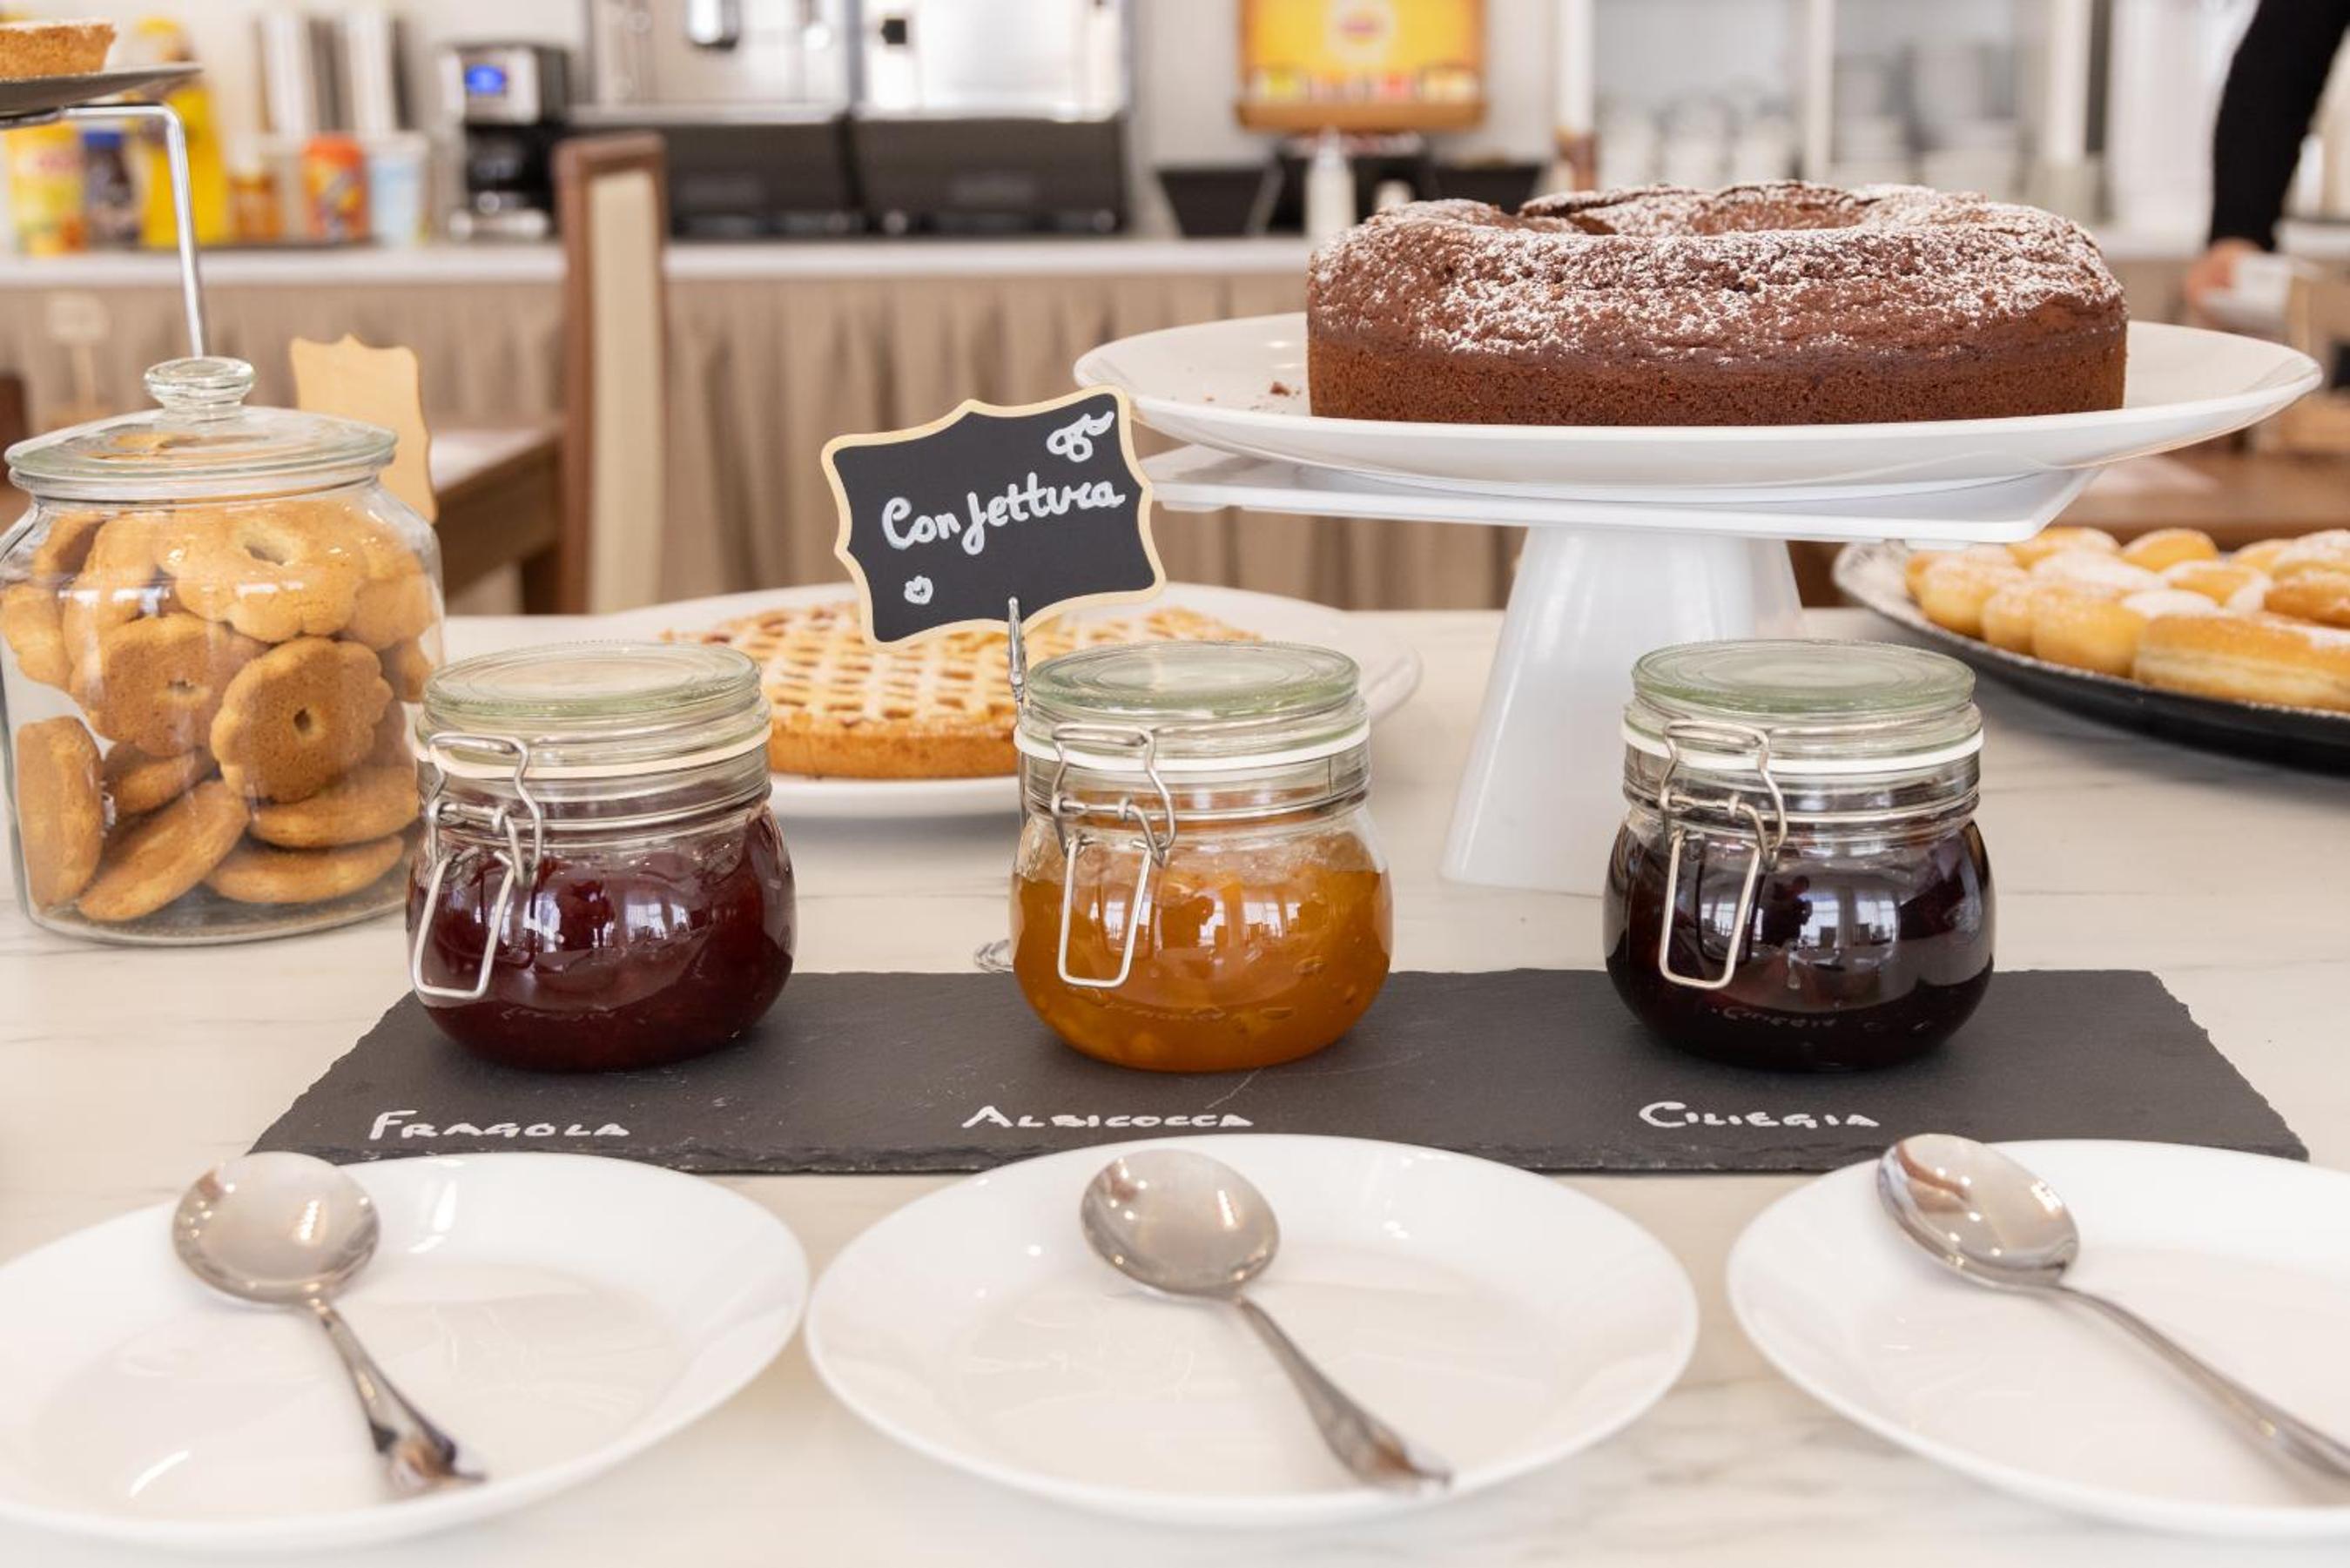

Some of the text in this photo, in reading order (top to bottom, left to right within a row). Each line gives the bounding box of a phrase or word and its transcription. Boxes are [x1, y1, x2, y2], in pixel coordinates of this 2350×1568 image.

[882, 472, 1126, 555] Confettura
[368, 1109, 630, 1141] FRAGOLA
[961, 1105, 1254, 1128] ALBICOCCA
[1639, 1101, 1881, 1129] CILIEGIA
